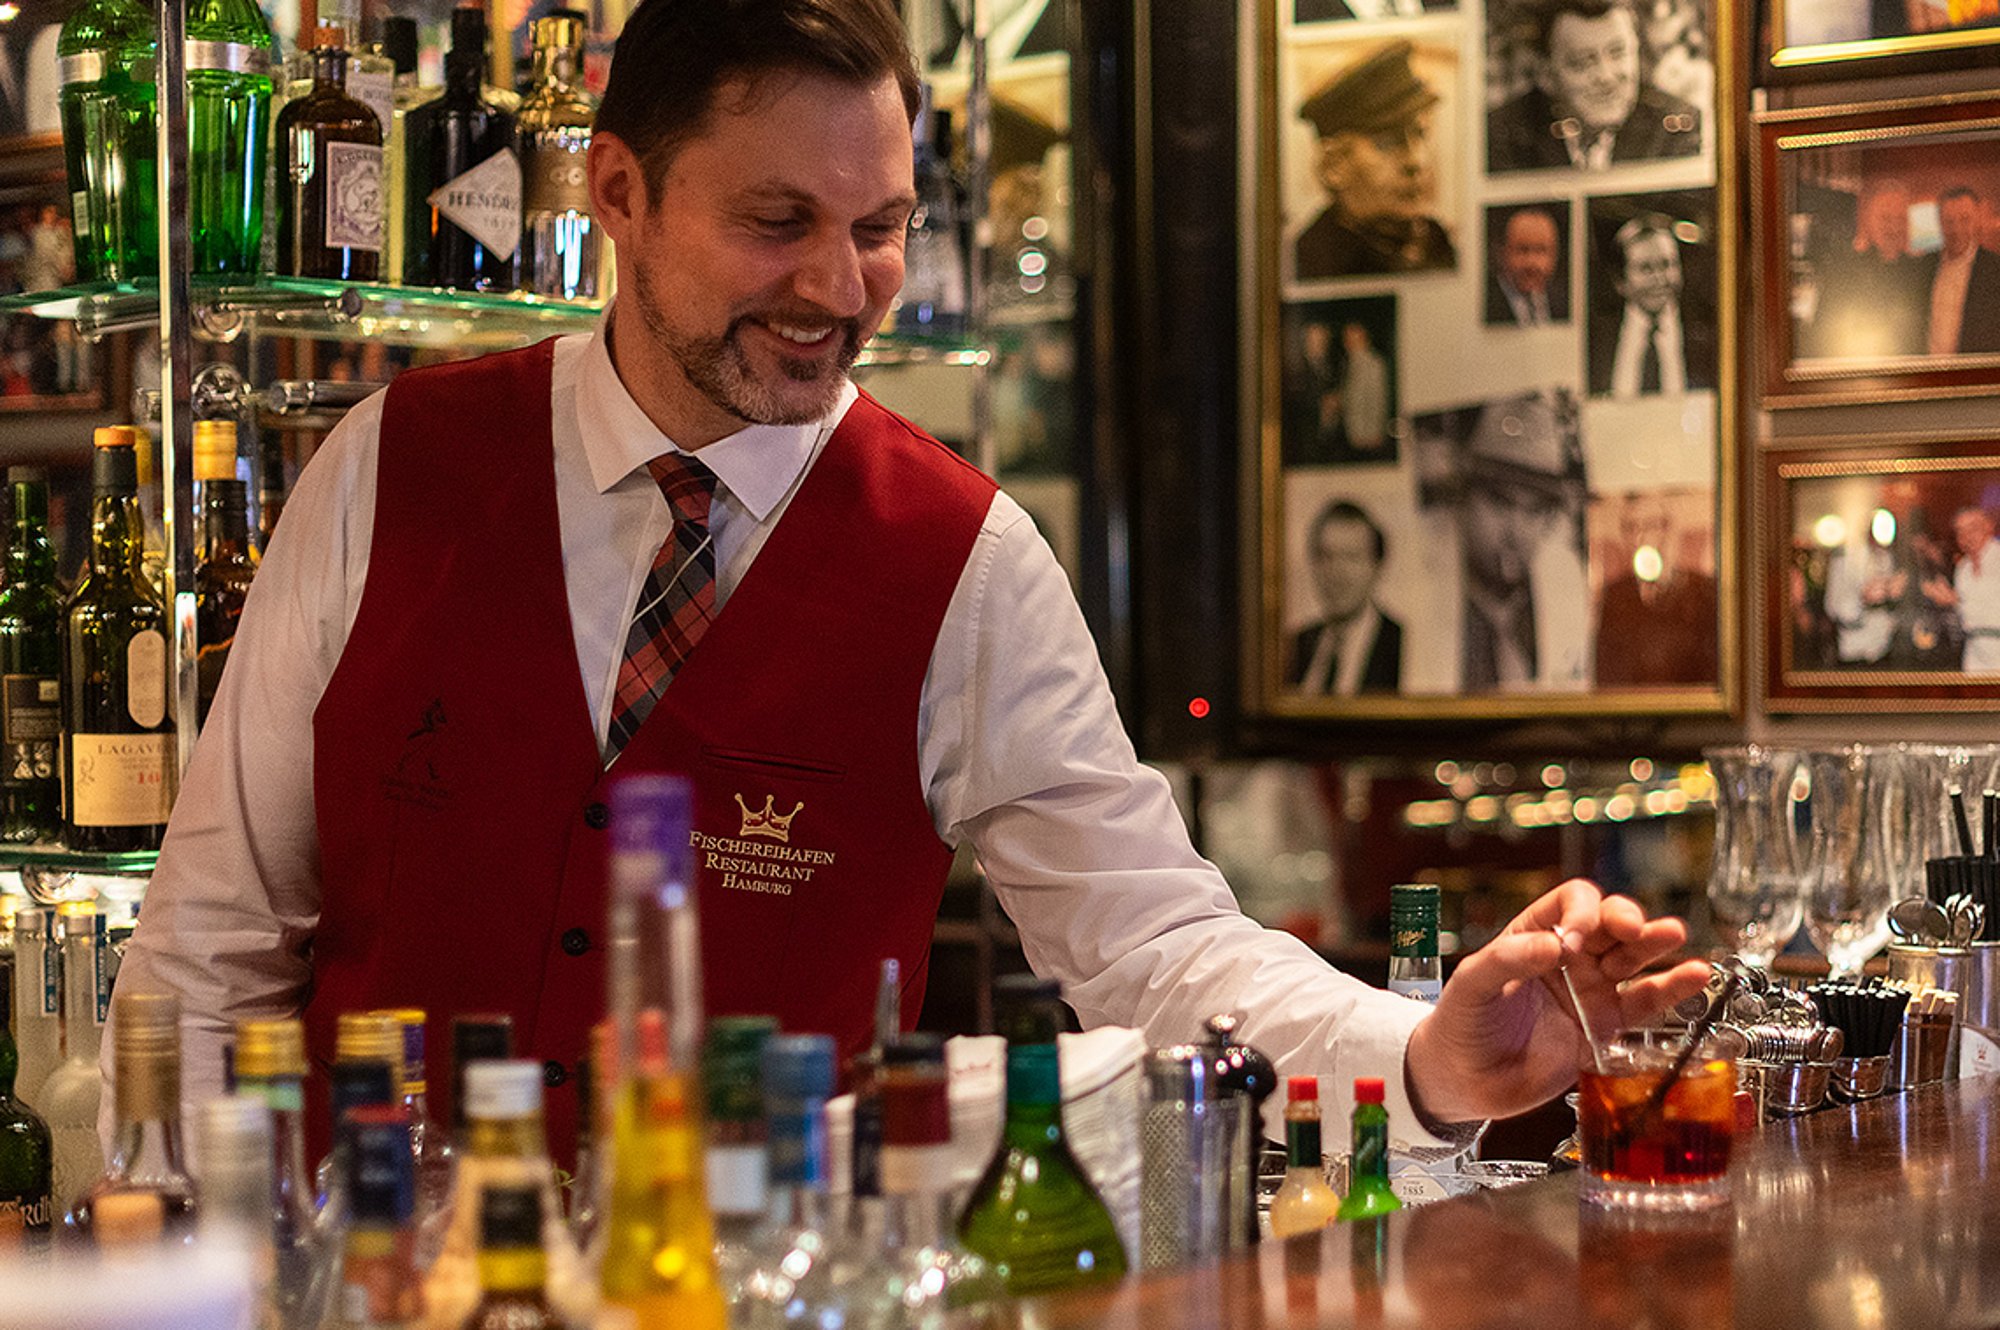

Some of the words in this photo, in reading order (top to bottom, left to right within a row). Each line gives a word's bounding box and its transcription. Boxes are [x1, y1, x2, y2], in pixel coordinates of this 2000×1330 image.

[688, 831, 836, 865] FISCHEREIHAFEN
[704, 852, 815, 882] RESTAURANT
[721, 873, 792, 896] HAMBURG
